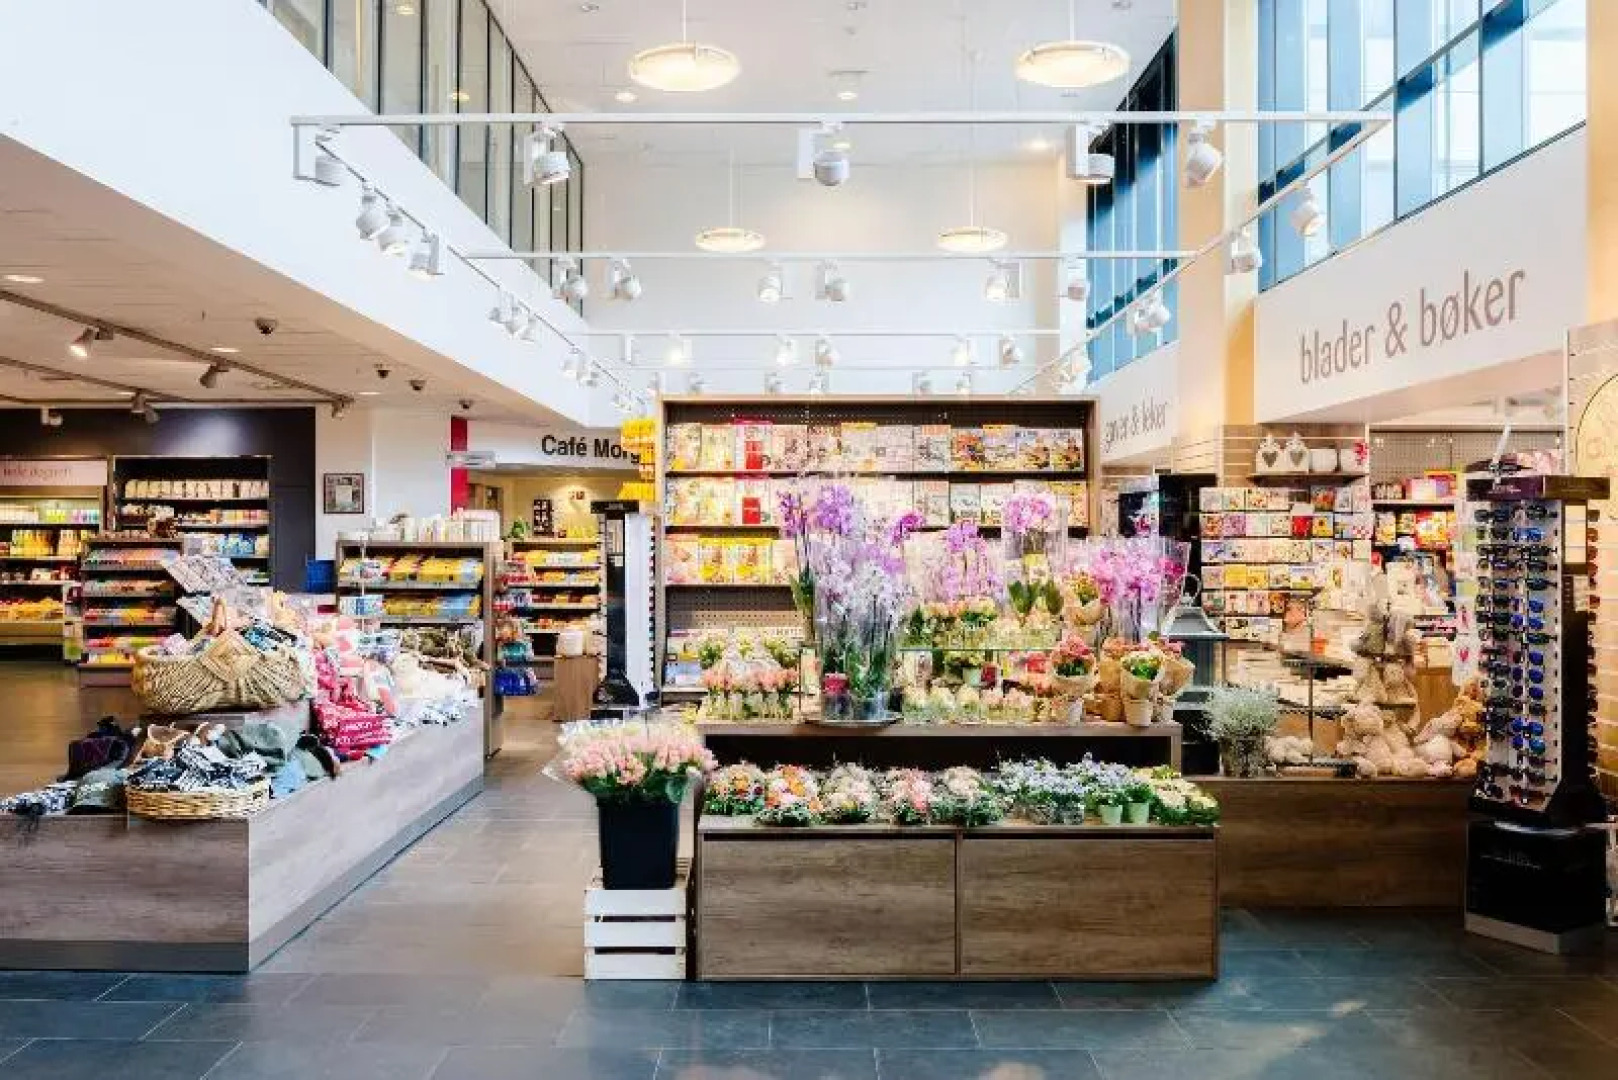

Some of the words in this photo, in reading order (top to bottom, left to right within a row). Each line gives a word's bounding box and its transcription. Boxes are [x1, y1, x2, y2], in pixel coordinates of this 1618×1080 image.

[1299, 319, 1376, 384] blader
[1384, 301, 1408, 358] &
[1419, 269, 1526, 347] bøker
[541, 434, 587, 456] Café
